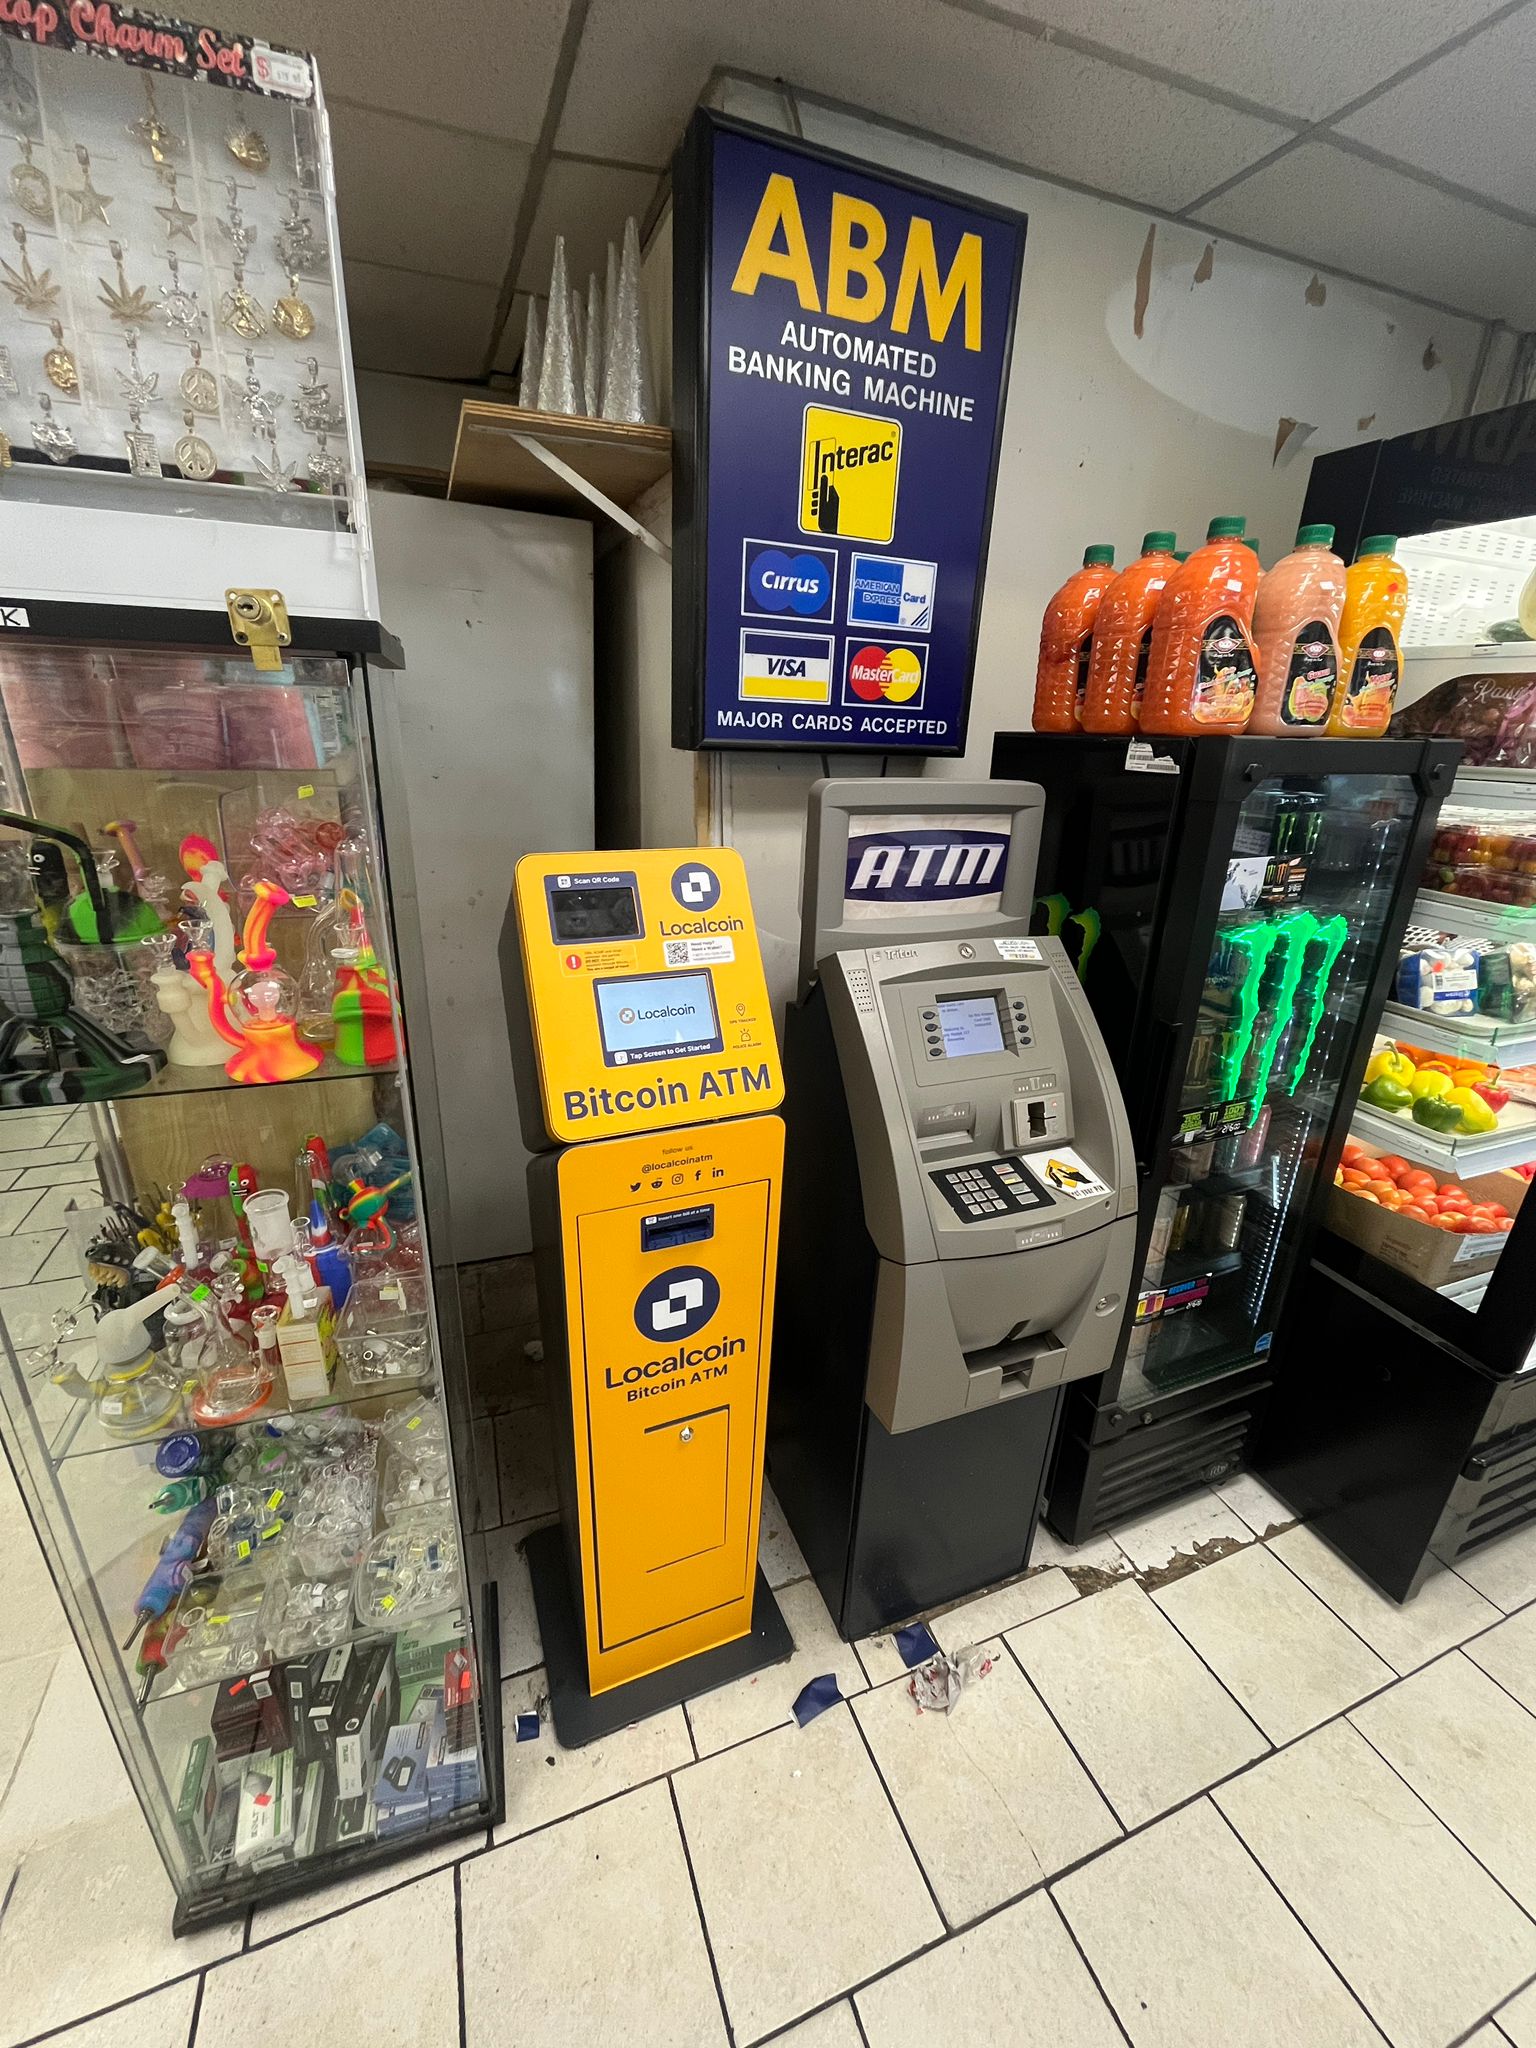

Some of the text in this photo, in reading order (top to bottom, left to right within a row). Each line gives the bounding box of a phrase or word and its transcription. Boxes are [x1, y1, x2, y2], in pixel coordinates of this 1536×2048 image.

[69, 0, 188, 63] Charm
[197, 28, 246, 78] Set
[730, 172, 983, 352] ABM
[780, 320, 937, 379] AUTOMATED
[728, 345, 975, 422] BANKING MACHINE
[813, 439, 893, 488] Interac
[761, 570, 819, 594] Cirrus
[854, 578, 900, 594] AMERICAN
[863, 592, 926, 606] EXPRESS Card
[767, 658, 807, 678] VISA
[851, 664, 919, 684] MasterCard
[717, 709, 948, 735] MAJOR CARDS ACCEPTED
[850, 843, 1005, 890] ATM
[659, 916, 744, 937] Localcoin
[884, 949, 918, 960] Triton
[637, 1004, 696, 1020] Localcoin
[643, 1050, 667, 1058] Screen
[687, 1043, 711, 1052] Started
[563, 1063, 772, 1121] Bitcoin ATM
[662, 1147, 683, 1155] follow
[641, 1154, 713, 1174] @localcoinatm
[604, 1336, 746, 1389] Localcoin
[627, 1363, 728, 1403] Bitcoin ATM
